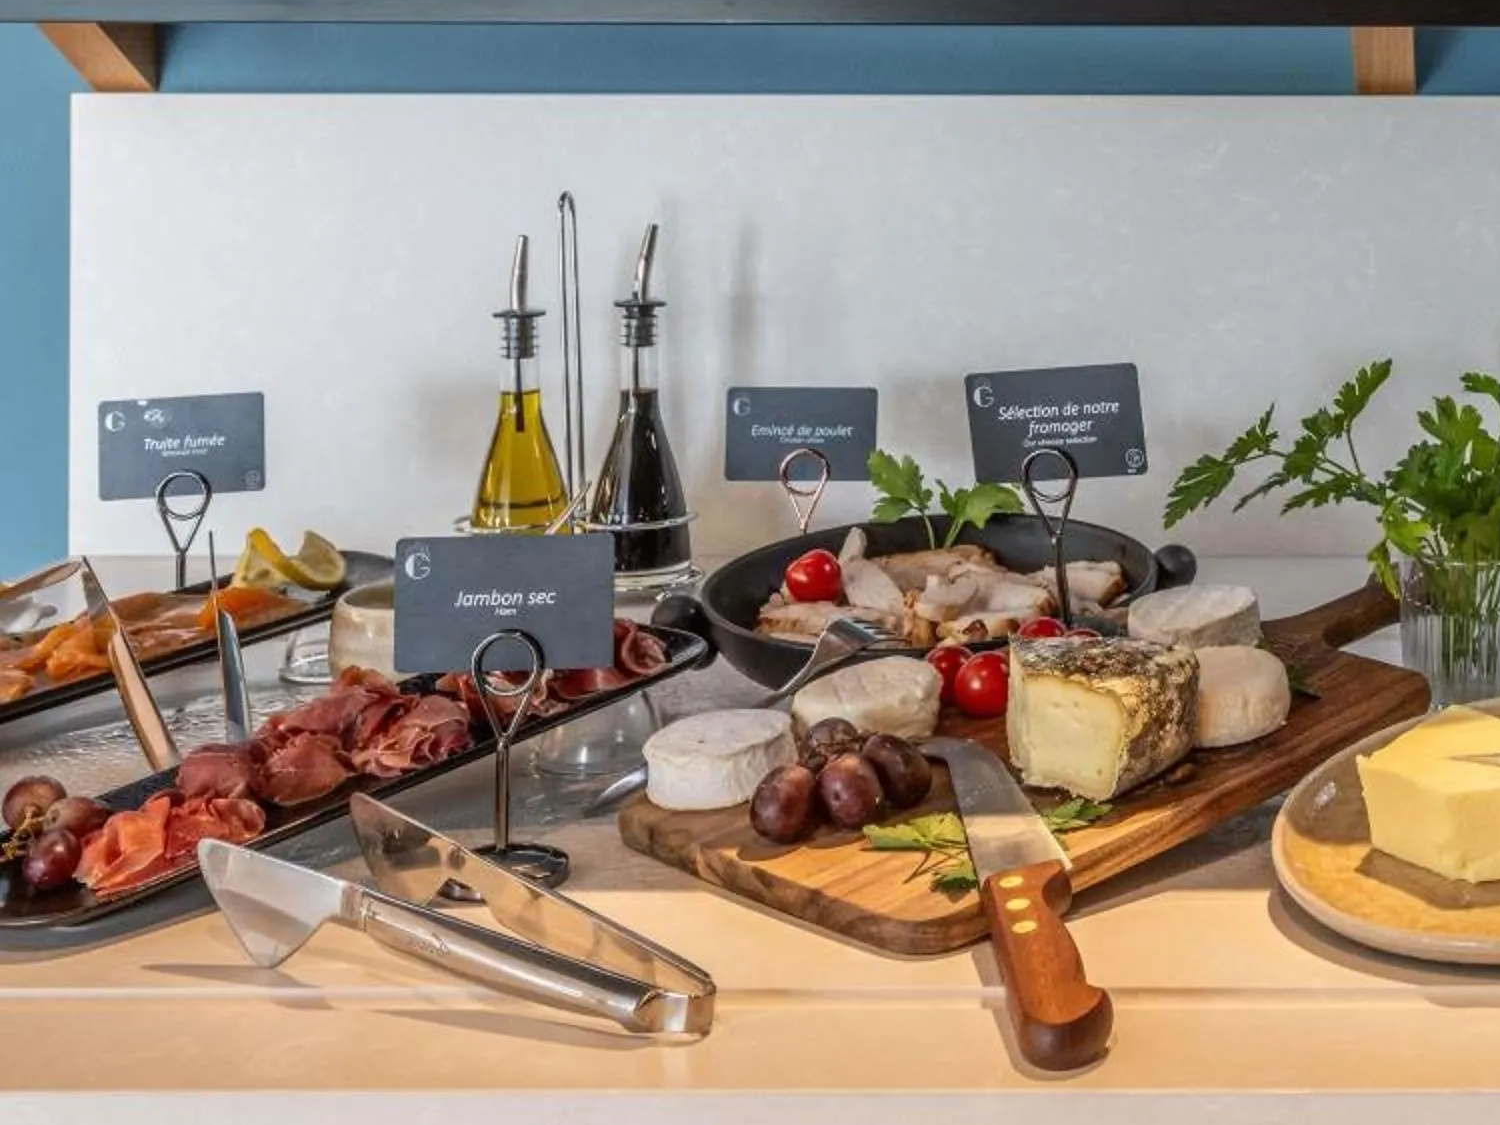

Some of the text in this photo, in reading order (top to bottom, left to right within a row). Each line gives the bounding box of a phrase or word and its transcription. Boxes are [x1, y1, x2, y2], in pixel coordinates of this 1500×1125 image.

[998, 400, 1120, 420] Sélection de notre
[797, 424, 813, 436] de
[814, 424, 854, 438] poulet
[1027, 419, 1093, 437] fromager
[143, 436, 181, 452] Truite
[453, 588, 557, 608] Jambon sec
